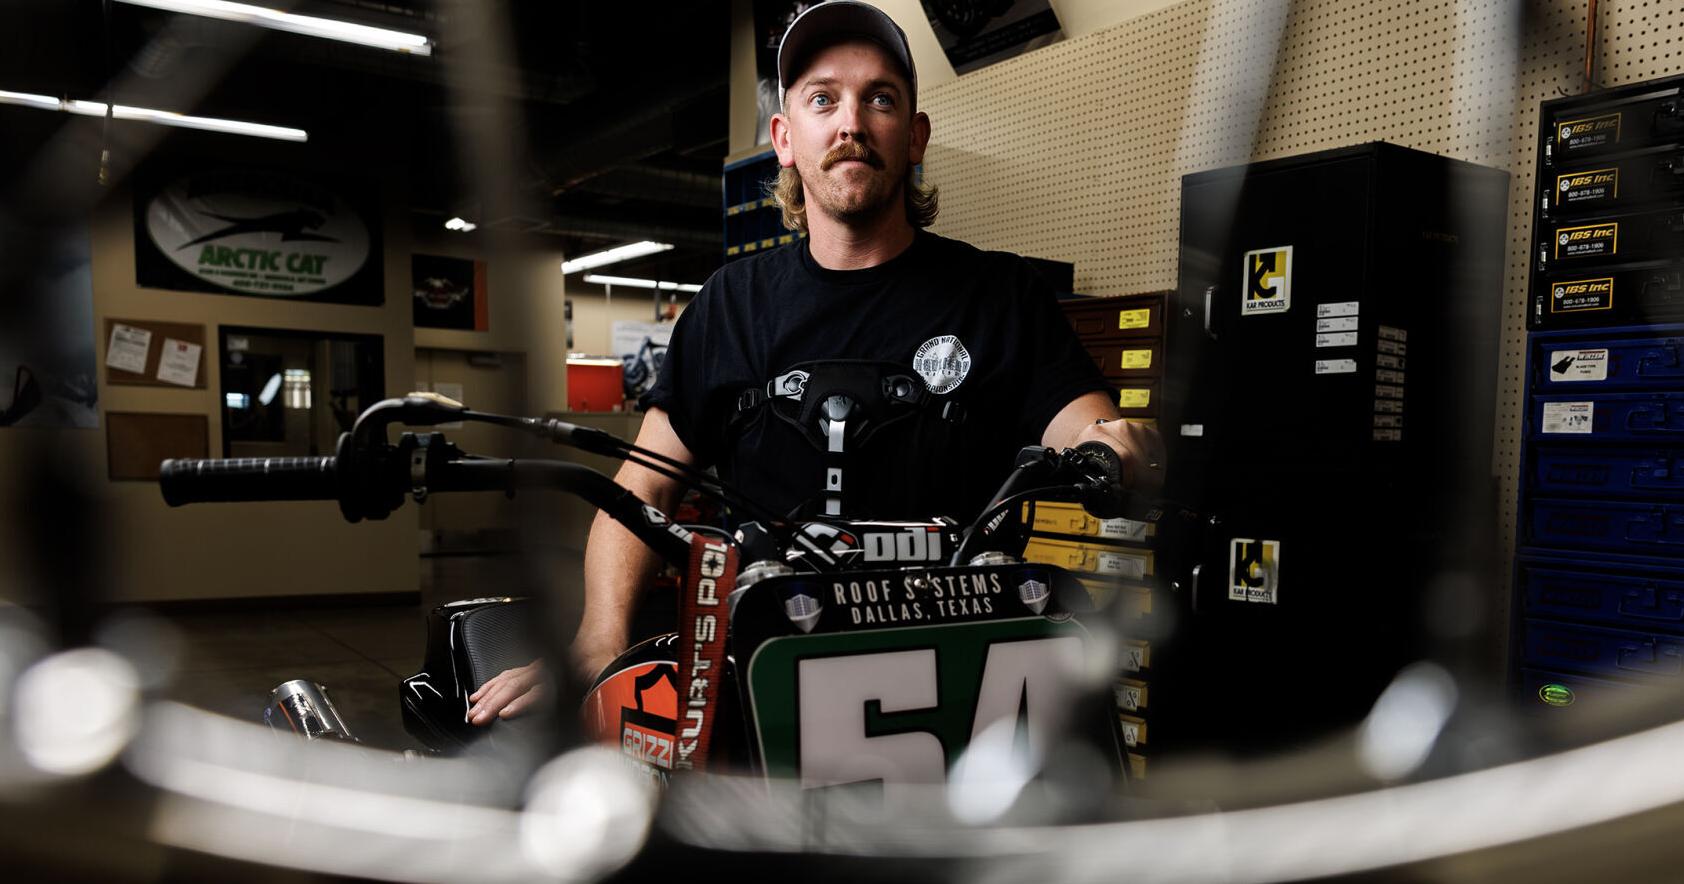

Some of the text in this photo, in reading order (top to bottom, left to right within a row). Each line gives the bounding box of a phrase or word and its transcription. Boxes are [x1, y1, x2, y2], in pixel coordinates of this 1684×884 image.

[1571, 122, 1594, 134] IBS
[1570, 173, 1615, 187] IBS Inc
[1569, 228, 1614, 241] IBS Inc
[198, 244, 328, 275] ARCTIC CAT
[1565, 282, 1610, 294] IBS Inc
[916, 336, 969, 360] GRAND NATIONAL
[832, 572, 1002, 605] ROOF SSTEMS
[850, 597, 994, 625] DALLAS, TEXAS
[677, 613, 717, 761] KURT'S
